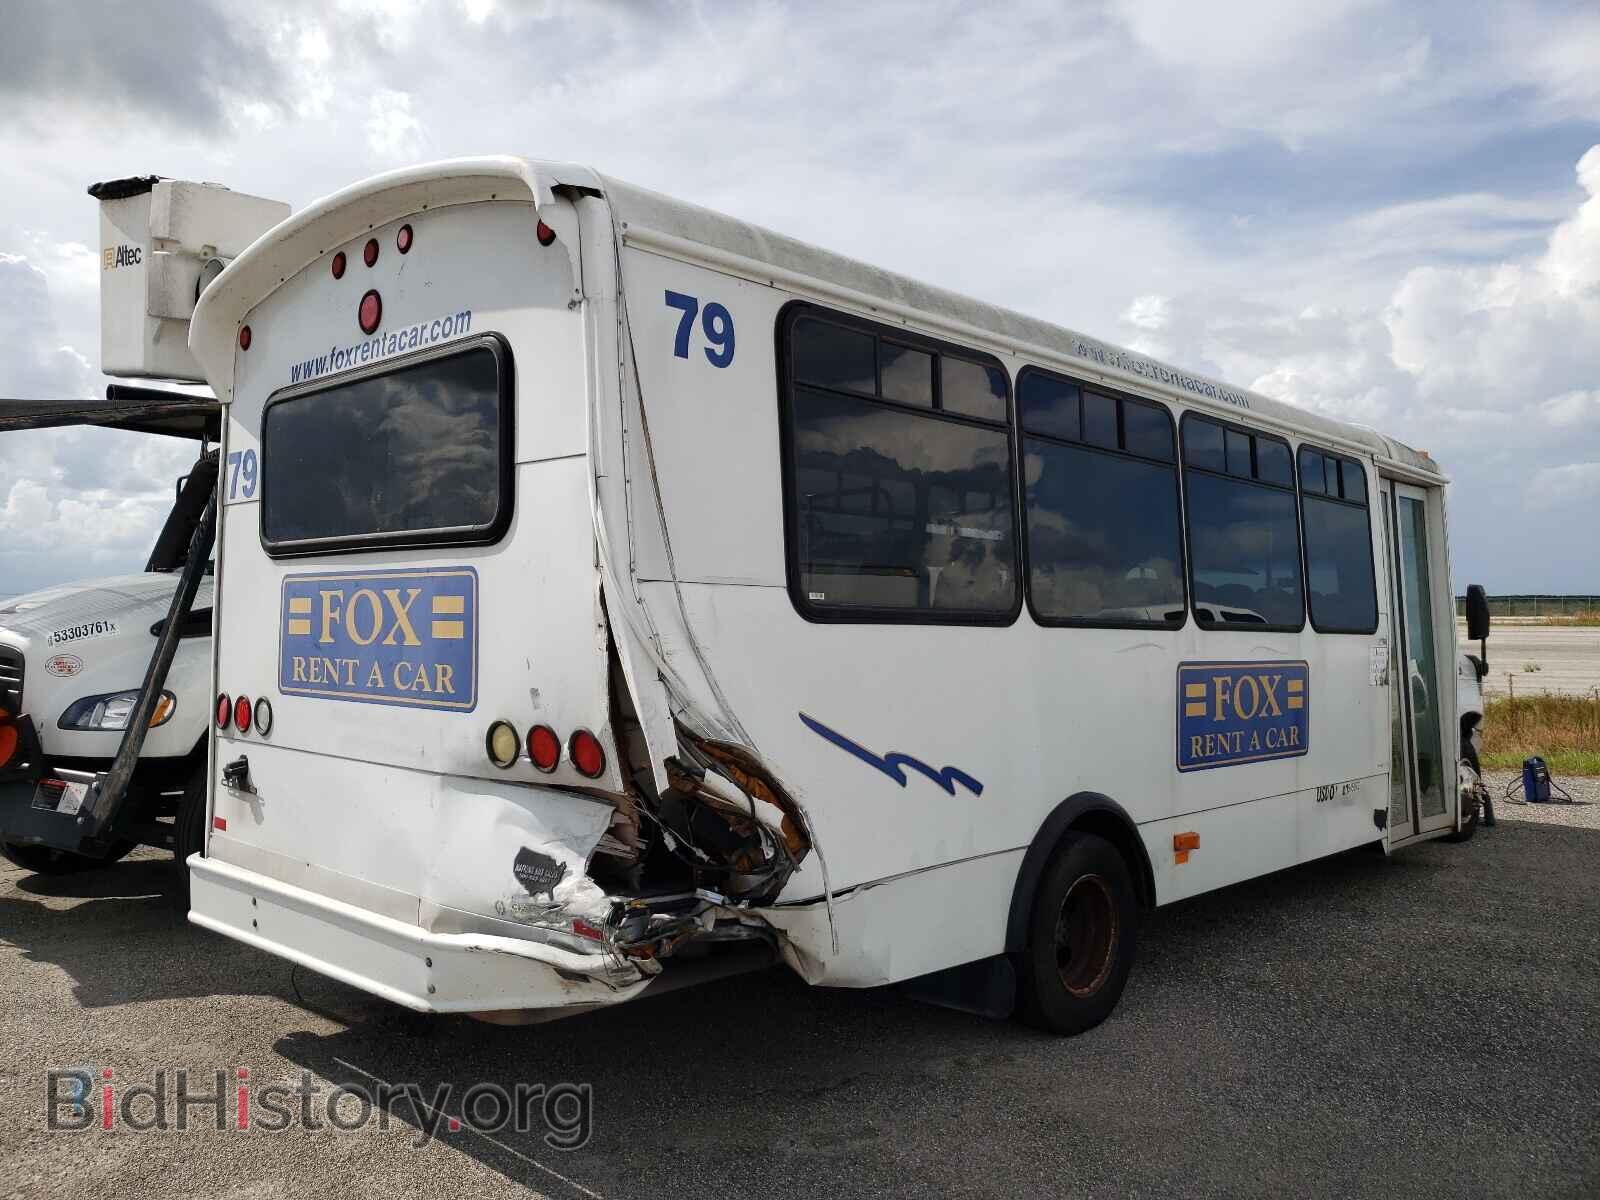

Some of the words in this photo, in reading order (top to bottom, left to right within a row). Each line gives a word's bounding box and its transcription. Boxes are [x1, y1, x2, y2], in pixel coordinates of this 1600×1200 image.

[115, 245, 142, 268] Altec
[291, 309, 472, 382] www.foxrentacar.com
[664, 289, 736, 369] 79
[228, 448, 258, 500] 79
[318, 588, 423, 646] FOX
[292, 656, 360, 687] RENT
[365, 660, 385, 689] A
[393, 661, 456, 695] CAR
[1211, 674, 1283, 722] FOX
[1190, 731, 1245, 759] RENT
[1247, 729, 1261, 752] A
[1265, 725, 1300, 749] CAR
